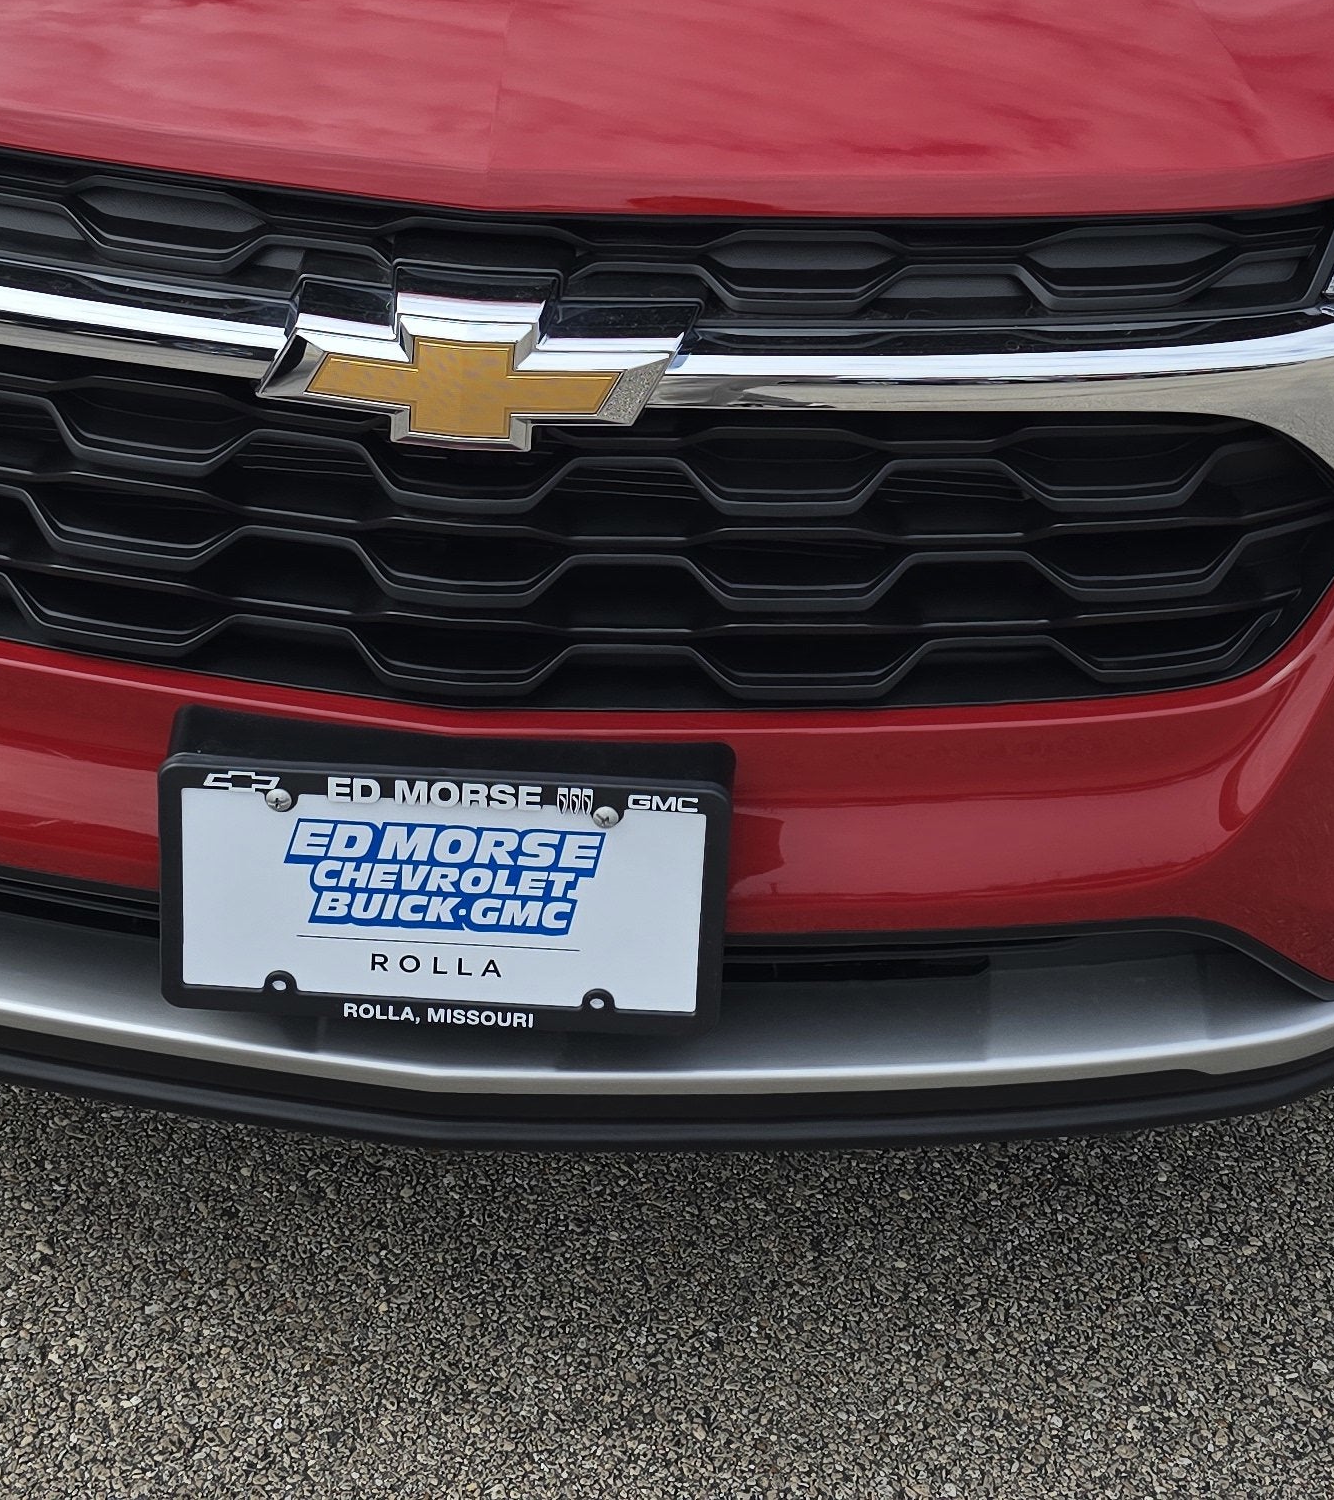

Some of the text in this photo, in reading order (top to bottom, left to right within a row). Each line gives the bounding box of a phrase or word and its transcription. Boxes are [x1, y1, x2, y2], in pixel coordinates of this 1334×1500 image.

[327, 776, 543, 813] ED MORSE
[627, 794, 699, 813] GMC
[289, 821, 601, 870] ED MORSE
[313, 860, 576, 898] CHEVROLET
[370, 953, 502, 978] ROLLA
[343, 1002, 534, 1029] ROLLA, MISSOURI
